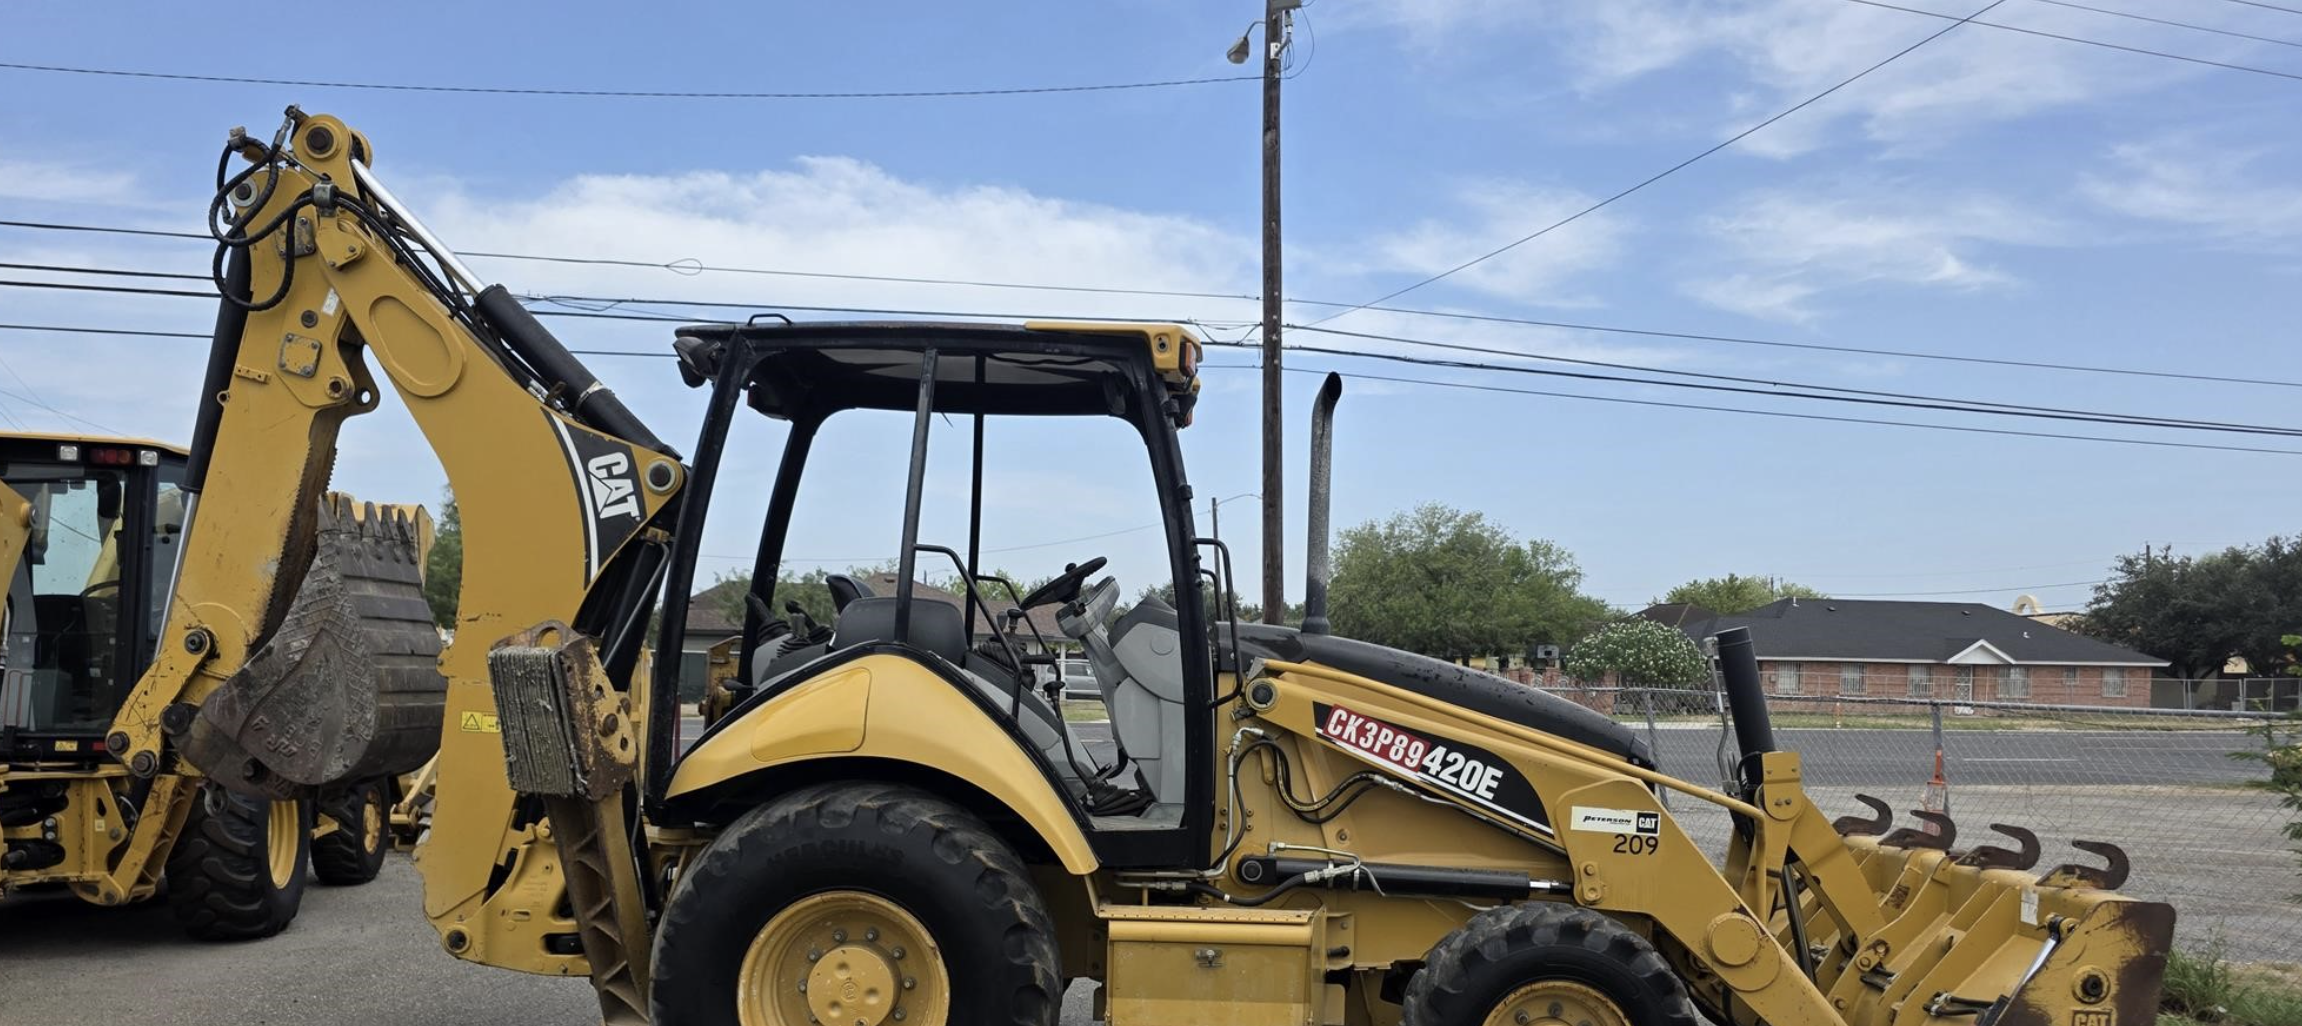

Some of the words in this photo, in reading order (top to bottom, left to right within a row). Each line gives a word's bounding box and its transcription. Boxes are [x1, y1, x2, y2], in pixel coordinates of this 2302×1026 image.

[588, 451, 640, 519] CAT
[1327, 709, 1425, 768] CK3P89
[1422, 745, 1503, 800] 420E
[1583, 815, 1632, 825] PETERSON
[1638, 817, 1657, 829] CAT
[1613, 833, 1659, 855] 209
